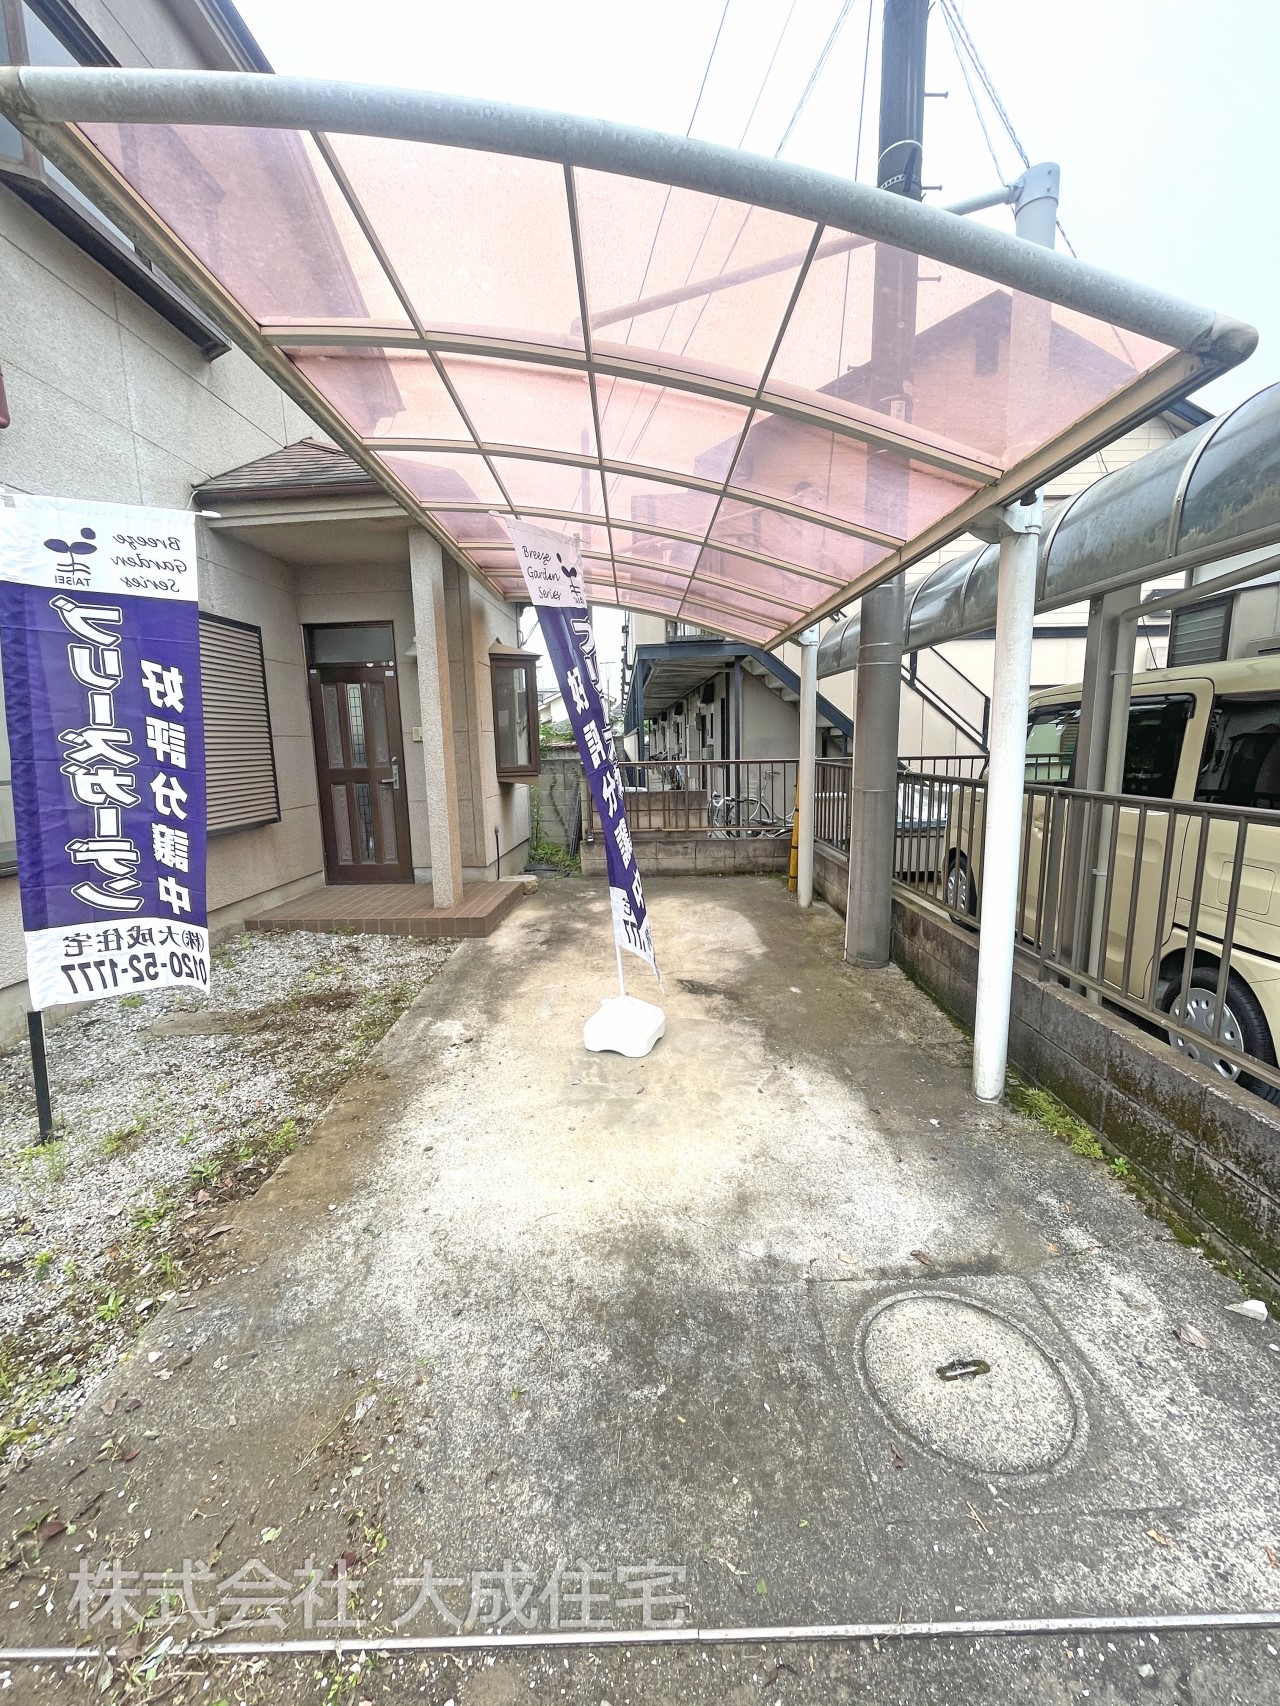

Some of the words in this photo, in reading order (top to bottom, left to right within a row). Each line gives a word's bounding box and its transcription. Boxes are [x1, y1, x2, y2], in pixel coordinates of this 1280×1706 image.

[522, 545, 551, 565] Breeze
[527, 566, 560, 581] Garden
[538, 587, 561, 600] Series
